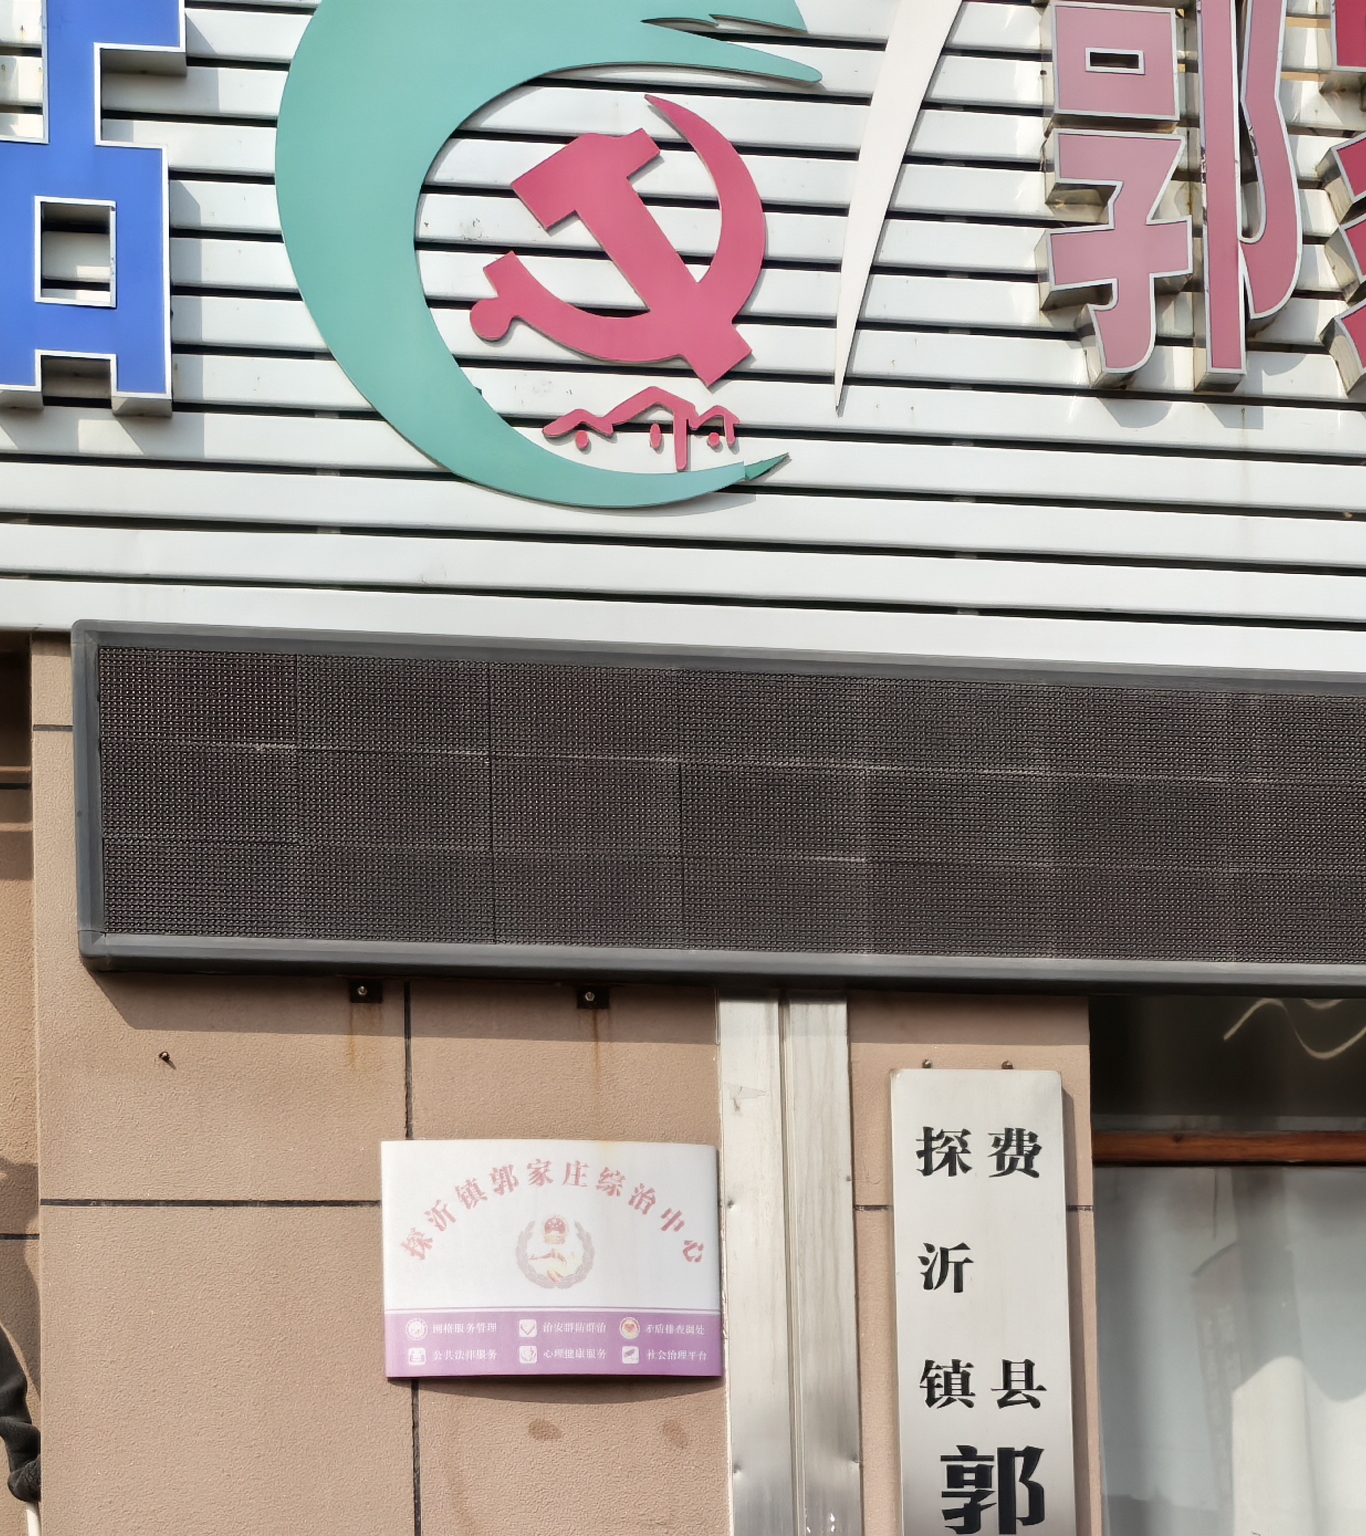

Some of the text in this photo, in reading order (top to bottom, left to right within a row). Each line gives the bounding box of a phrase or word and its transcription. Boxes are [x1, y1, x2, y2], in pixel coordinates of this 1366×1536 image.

[399, 1157, 706, 1264] 探沂镇郭家庄综治中心
[916, 1126, 976, 1410] 探沂镇
[988, 1126, 1048, 1410] 费县
